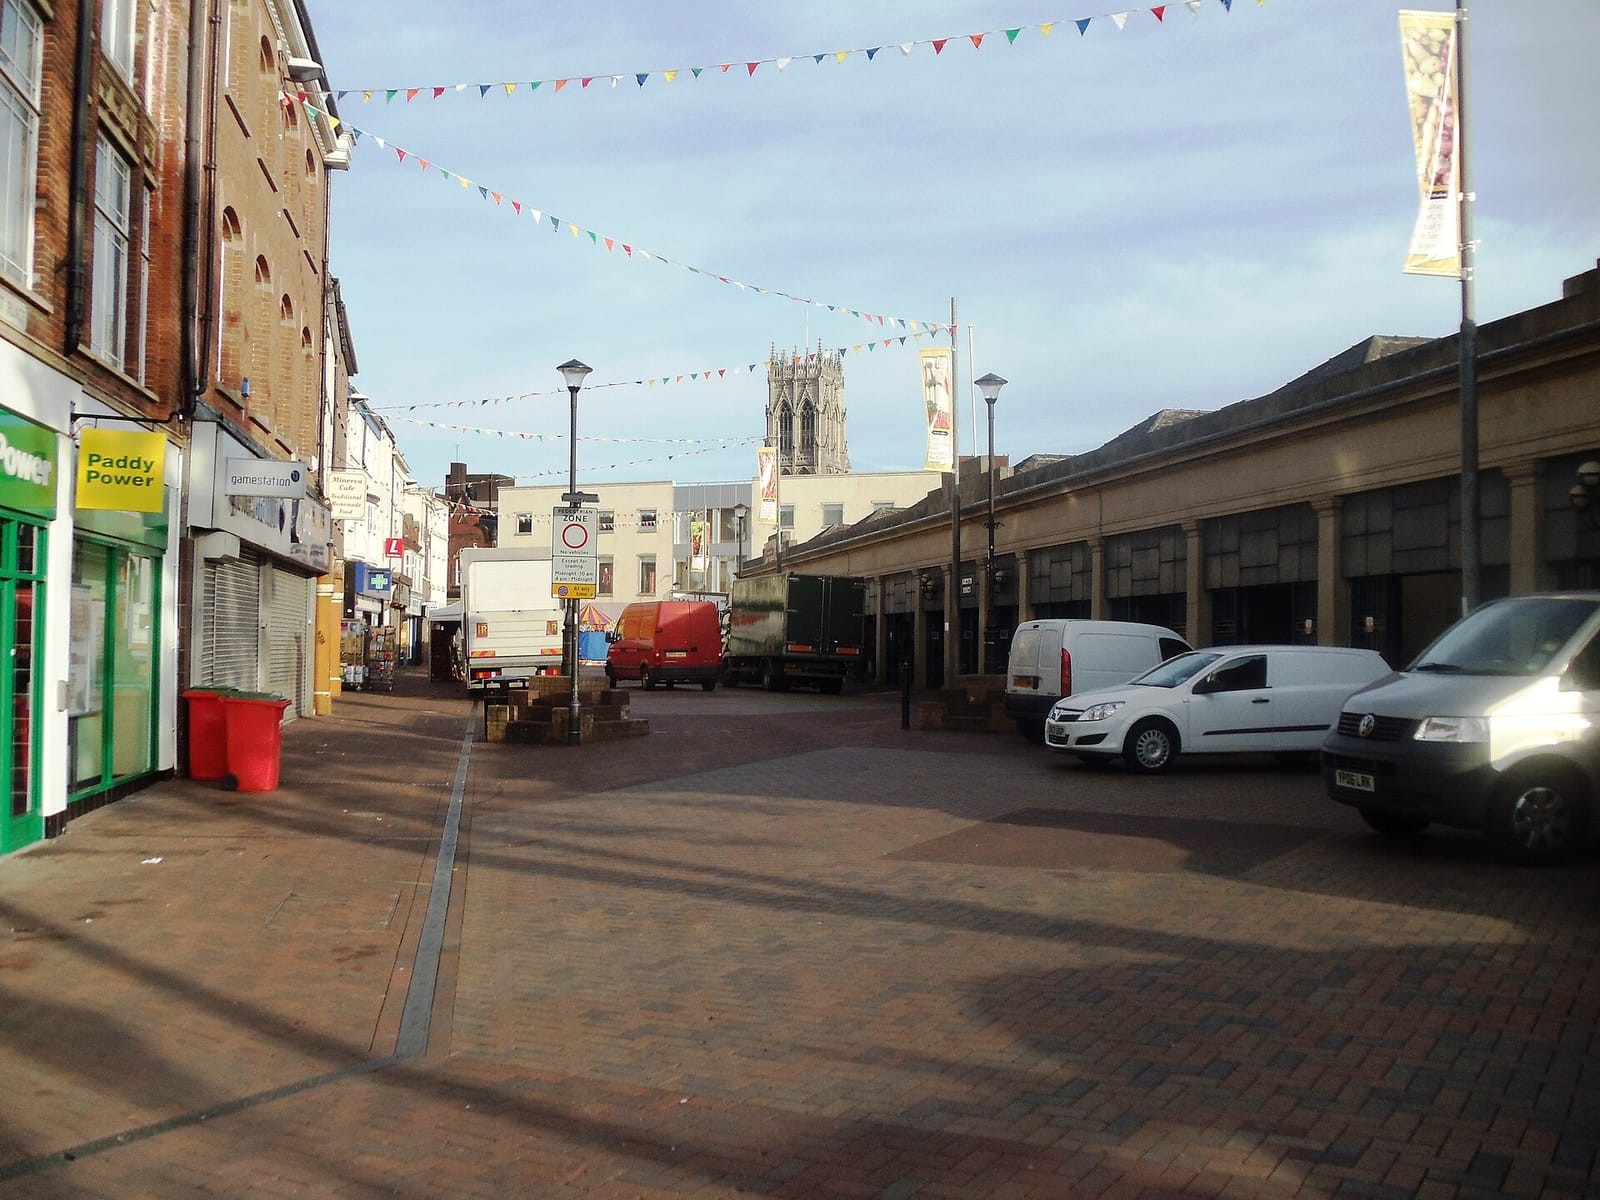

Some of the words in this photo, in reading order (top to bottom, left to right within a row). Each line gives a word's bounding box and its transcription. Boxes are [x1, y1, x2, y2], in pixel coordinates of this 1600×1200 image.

[88, 453, 154, 473] Paddy
[87, 470, 154, 486] Power
[231, 475, 291, 486] gamestation
